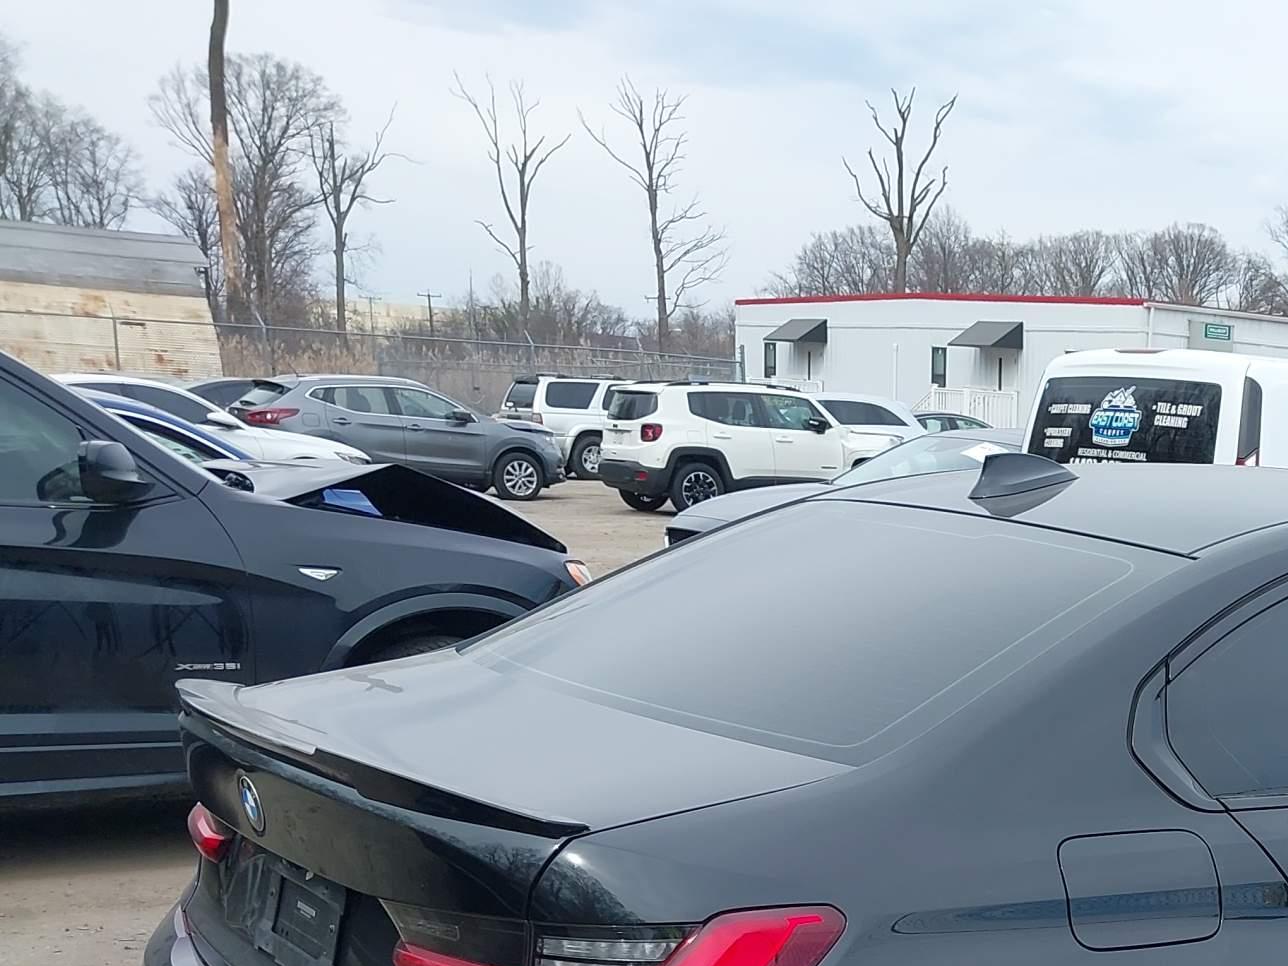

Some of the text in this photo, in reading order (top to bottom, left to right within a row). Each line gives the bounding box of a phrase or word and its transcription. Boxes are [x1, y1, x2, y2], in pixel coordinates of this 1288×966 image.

[1156, 402, 1171, 414] TILE
[1177, 404, 1204, 417] GROUT
[1092, 411, 1139, 427] EAST COAST
[1154, 415, 1188, 429] CLEANING
